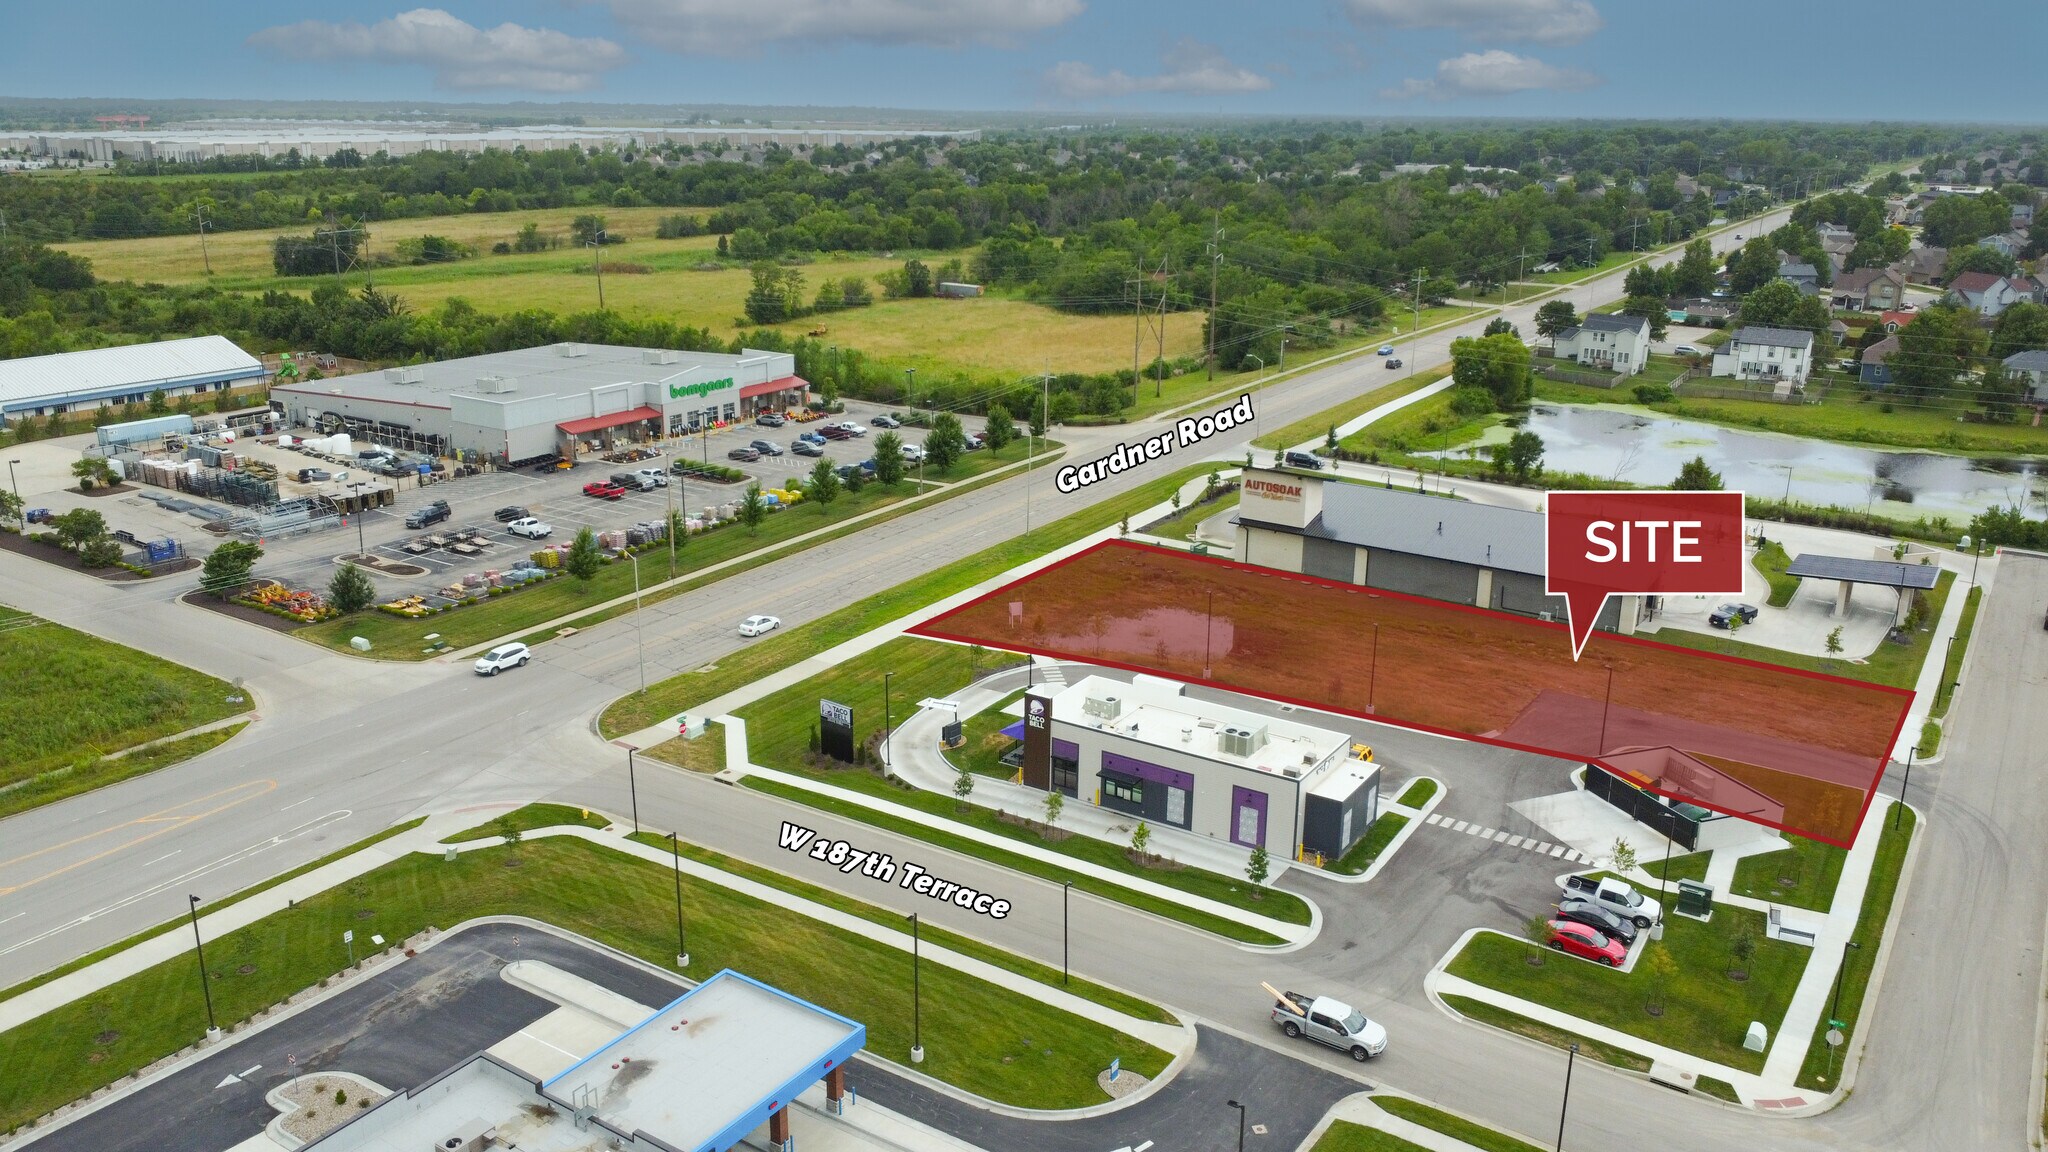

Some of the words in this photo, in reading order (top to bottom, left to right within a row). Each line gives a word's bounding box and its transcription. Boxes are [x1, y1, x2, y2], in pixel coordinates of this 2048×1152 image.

[669, 377, 733, 398] bomgaars
[1245, 479, 1302, 497] AUTOSOAK
[832, 705, 848, 716] TACO
[833, 712, 848, 723] BELL
[1028, 713, 1045, 724] TACO
[1029, 720, 1045, 729] BELL
